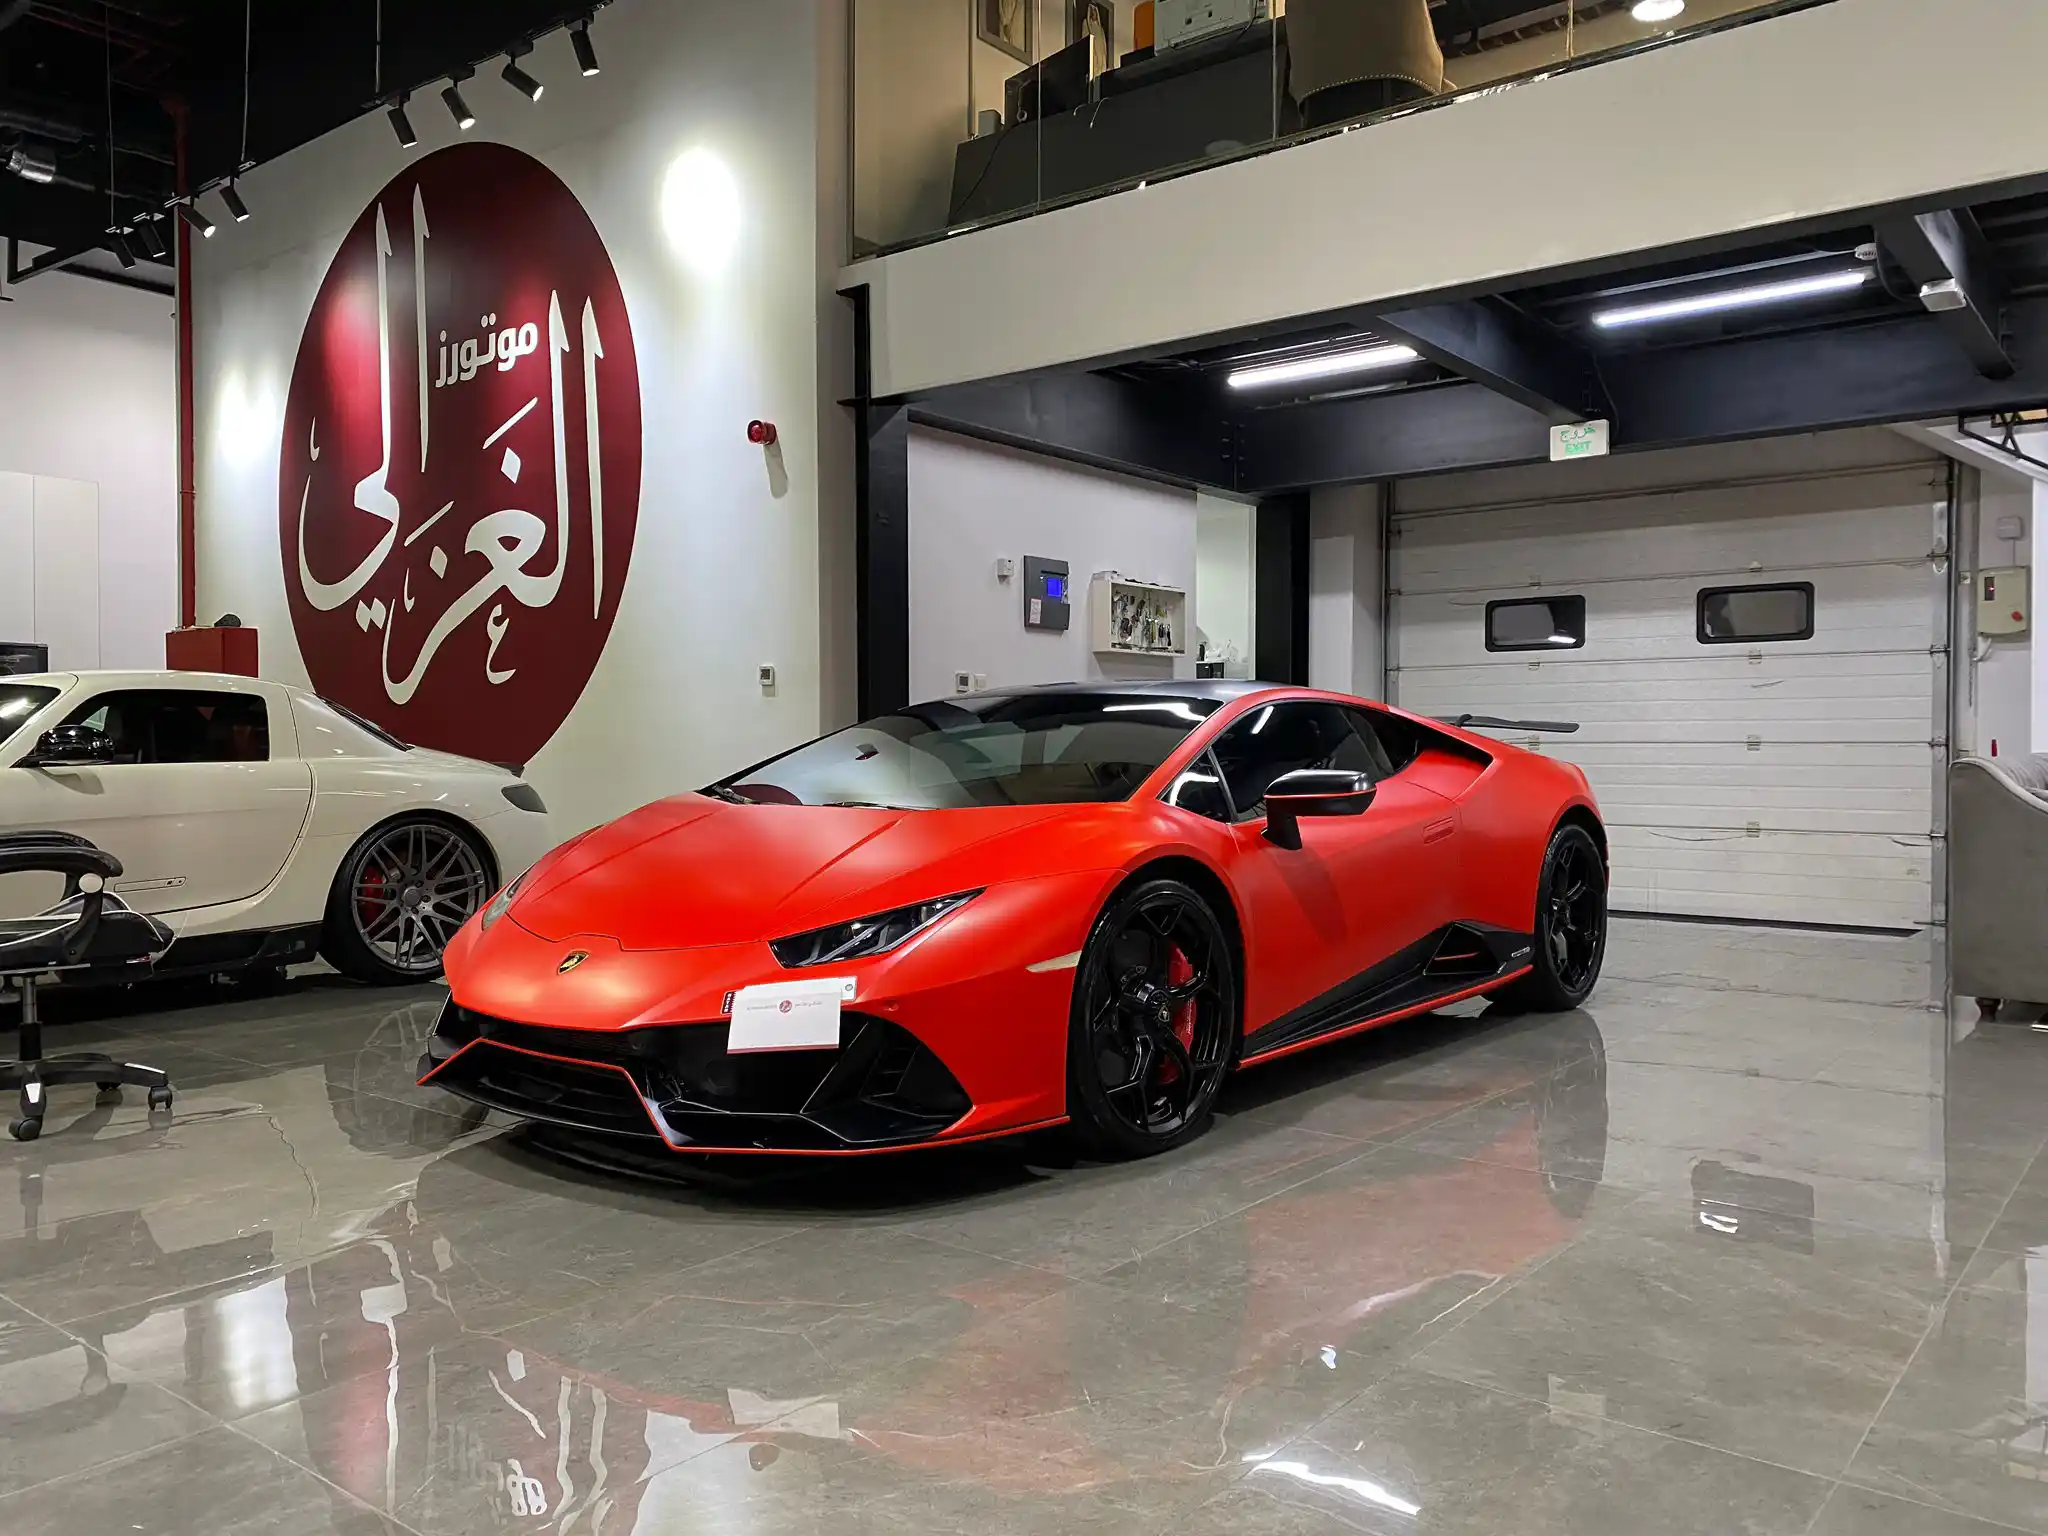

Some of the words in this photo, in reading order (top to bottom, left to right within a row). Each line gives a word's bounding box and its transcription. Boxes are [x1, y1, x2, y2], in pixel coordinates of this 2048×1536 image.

[435, 312, 539, 389] موتورز
[1560, 424, 1597, 443] خروج
[1565, 440, 1593, 454] EXIT
